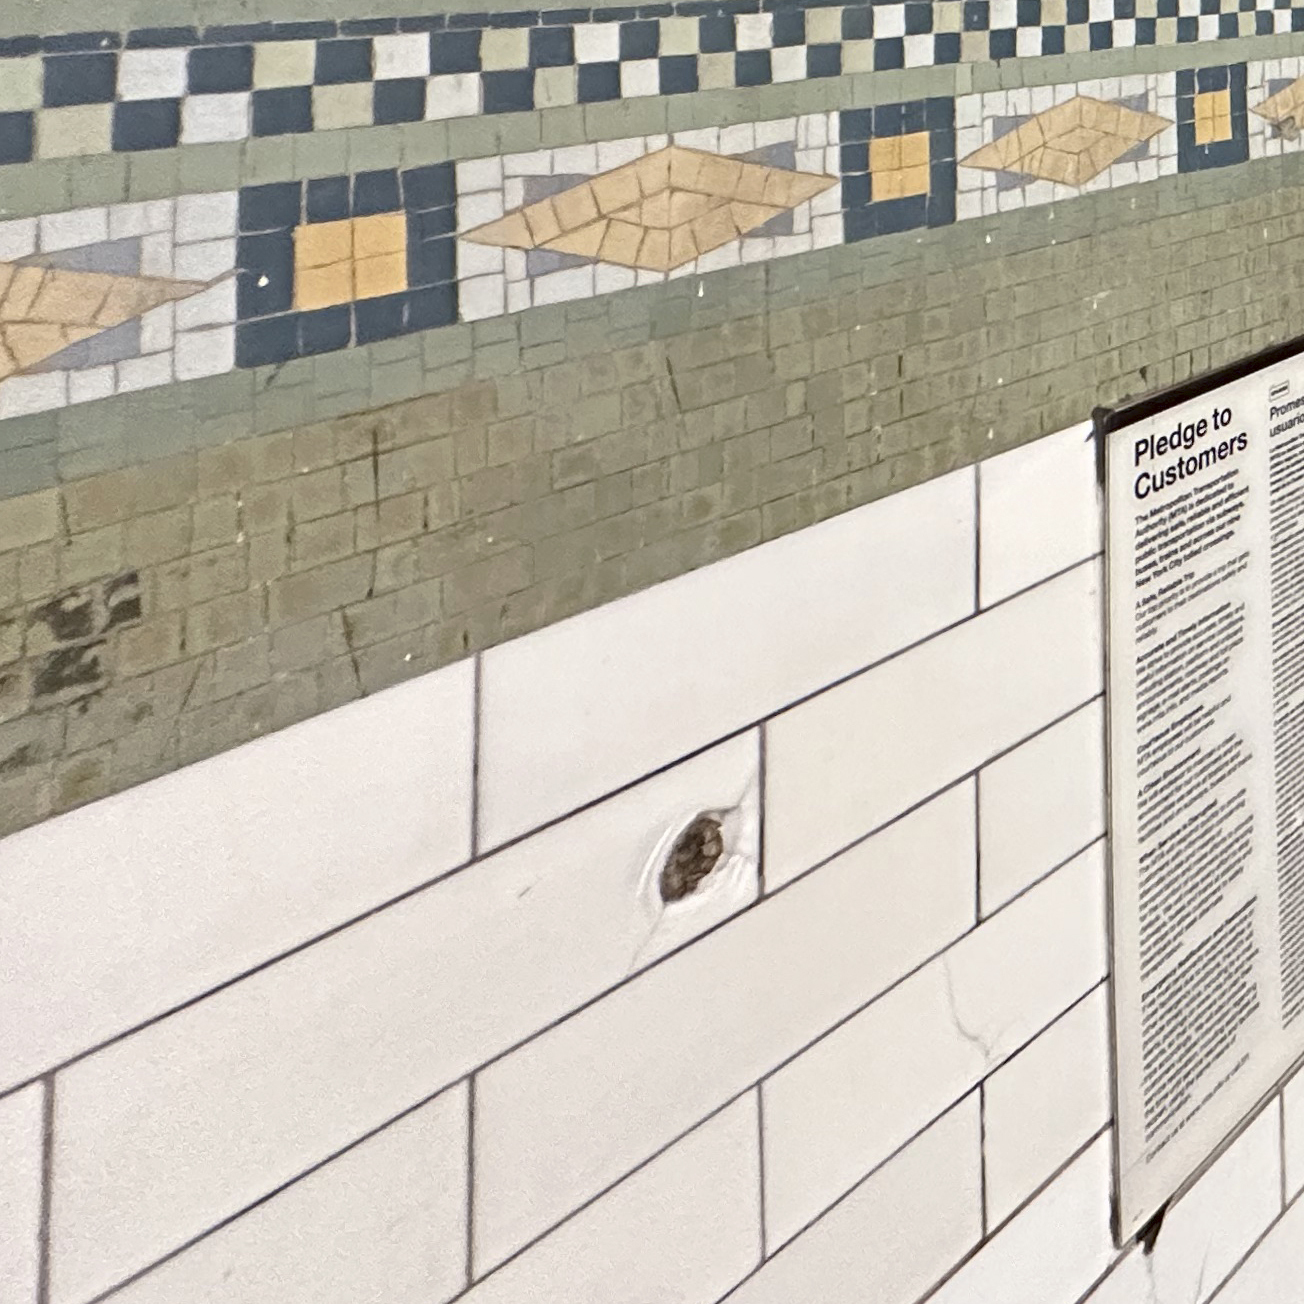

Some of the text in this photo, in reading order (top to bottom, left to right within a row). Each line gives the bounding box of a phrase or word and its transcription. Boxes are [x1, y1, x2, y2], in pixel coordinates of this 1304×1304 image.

[1134, 407, 1232, 467] Pledge to
[1134, 431, 1248, 499] Customers
